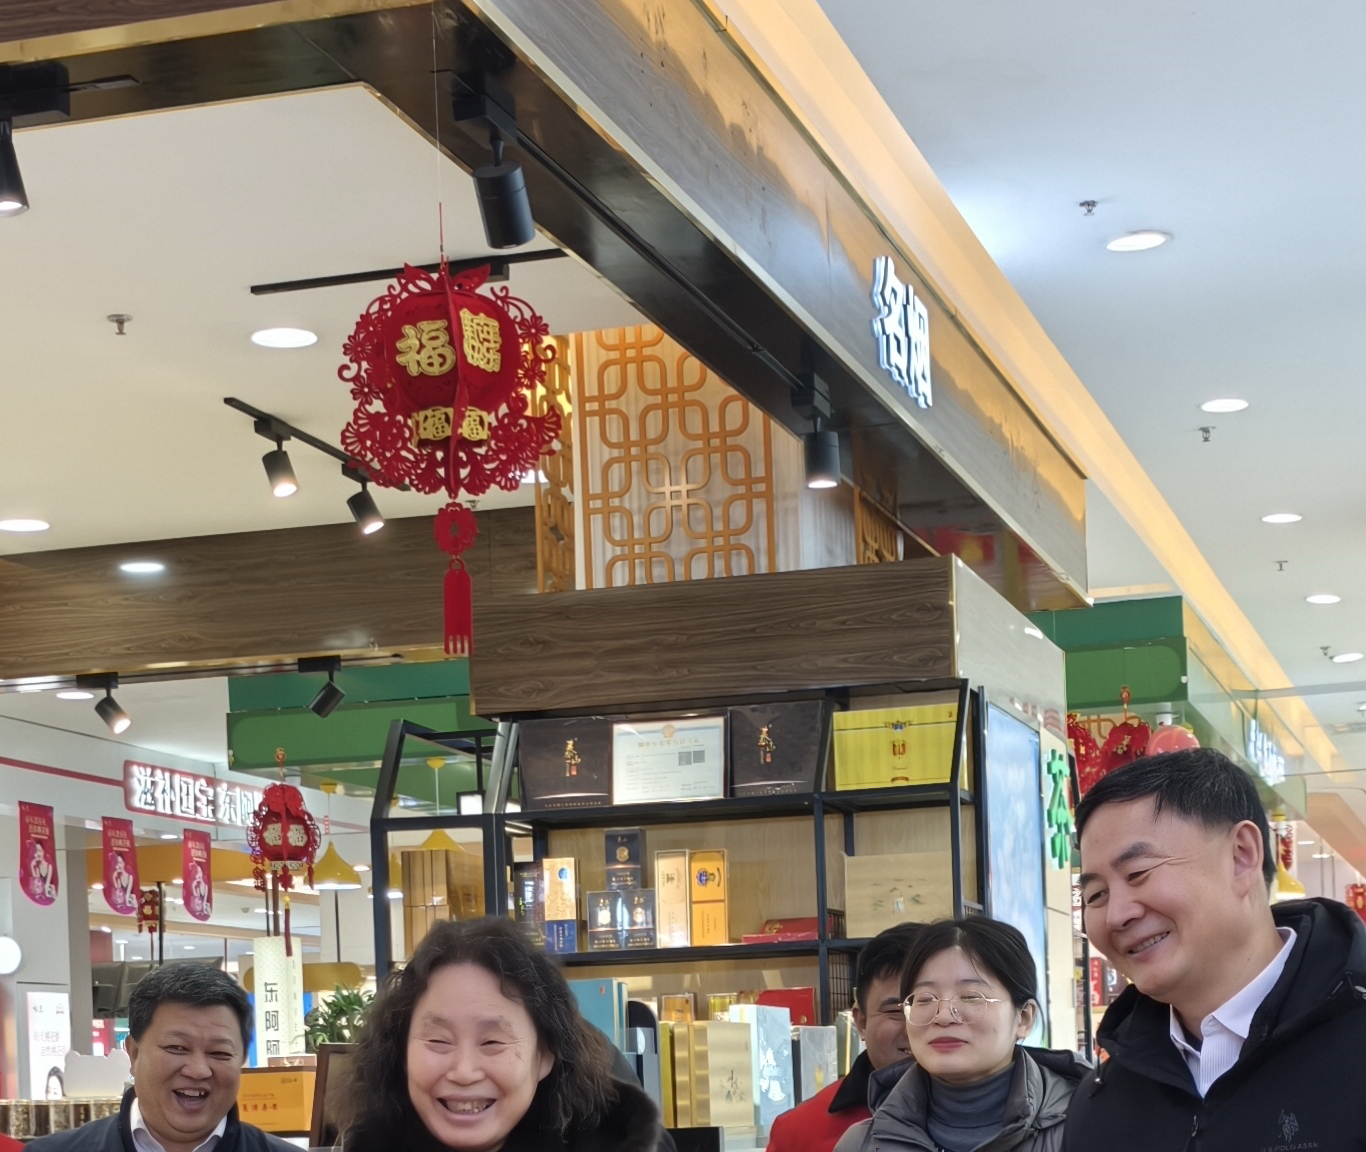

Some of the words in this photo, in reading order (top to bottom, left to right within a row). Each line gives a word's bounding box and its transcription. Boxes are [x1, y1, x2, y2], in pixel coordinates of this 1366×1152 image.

[396, 319, 456, 377] 福
[132, 765, 216, 822] 滋补国宝
[216, 780, 265, 828] 东阿
